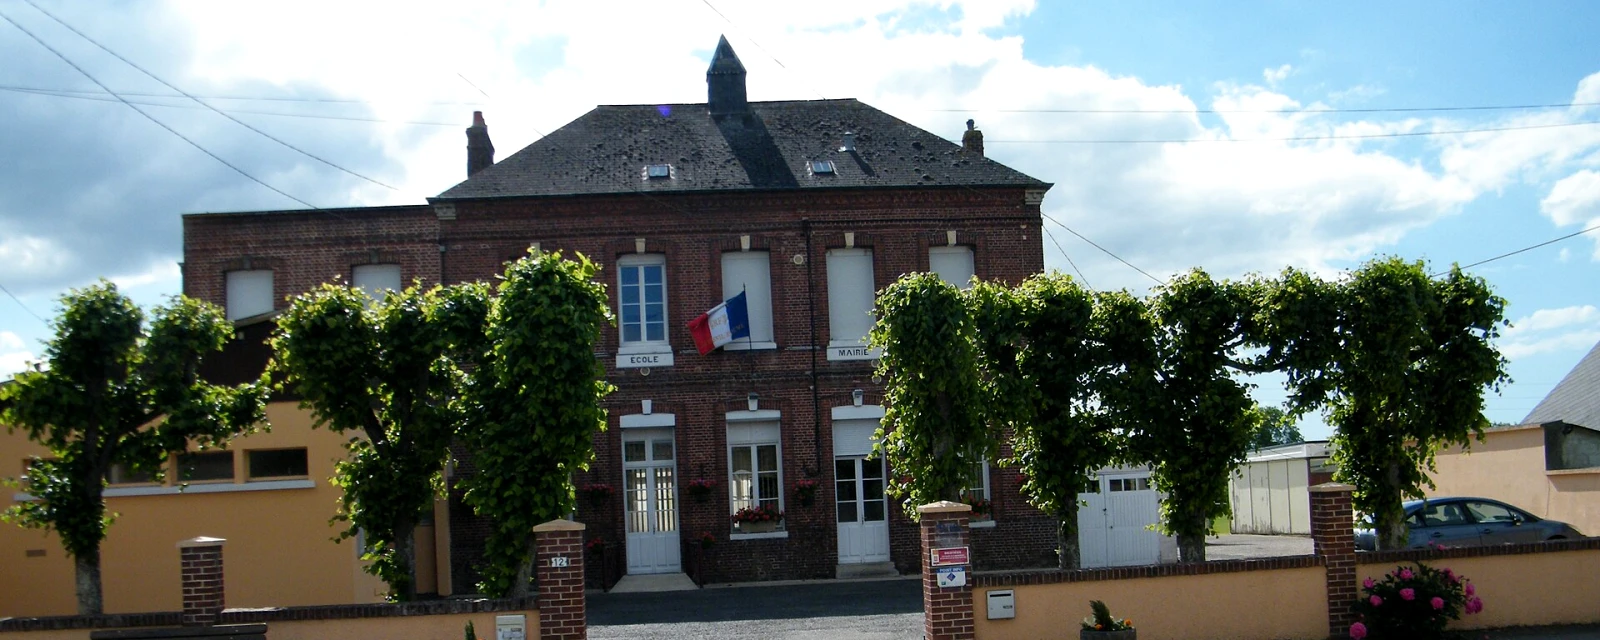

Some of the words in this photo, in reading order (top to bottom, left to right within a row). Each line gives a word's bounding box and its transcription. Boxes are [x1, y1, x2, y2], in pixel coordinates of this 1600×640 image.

[838, 348, 869, 356] MAIRIE
[630, 356, 659, 364] ECOLE
[554, 558, 565, 567] 12
